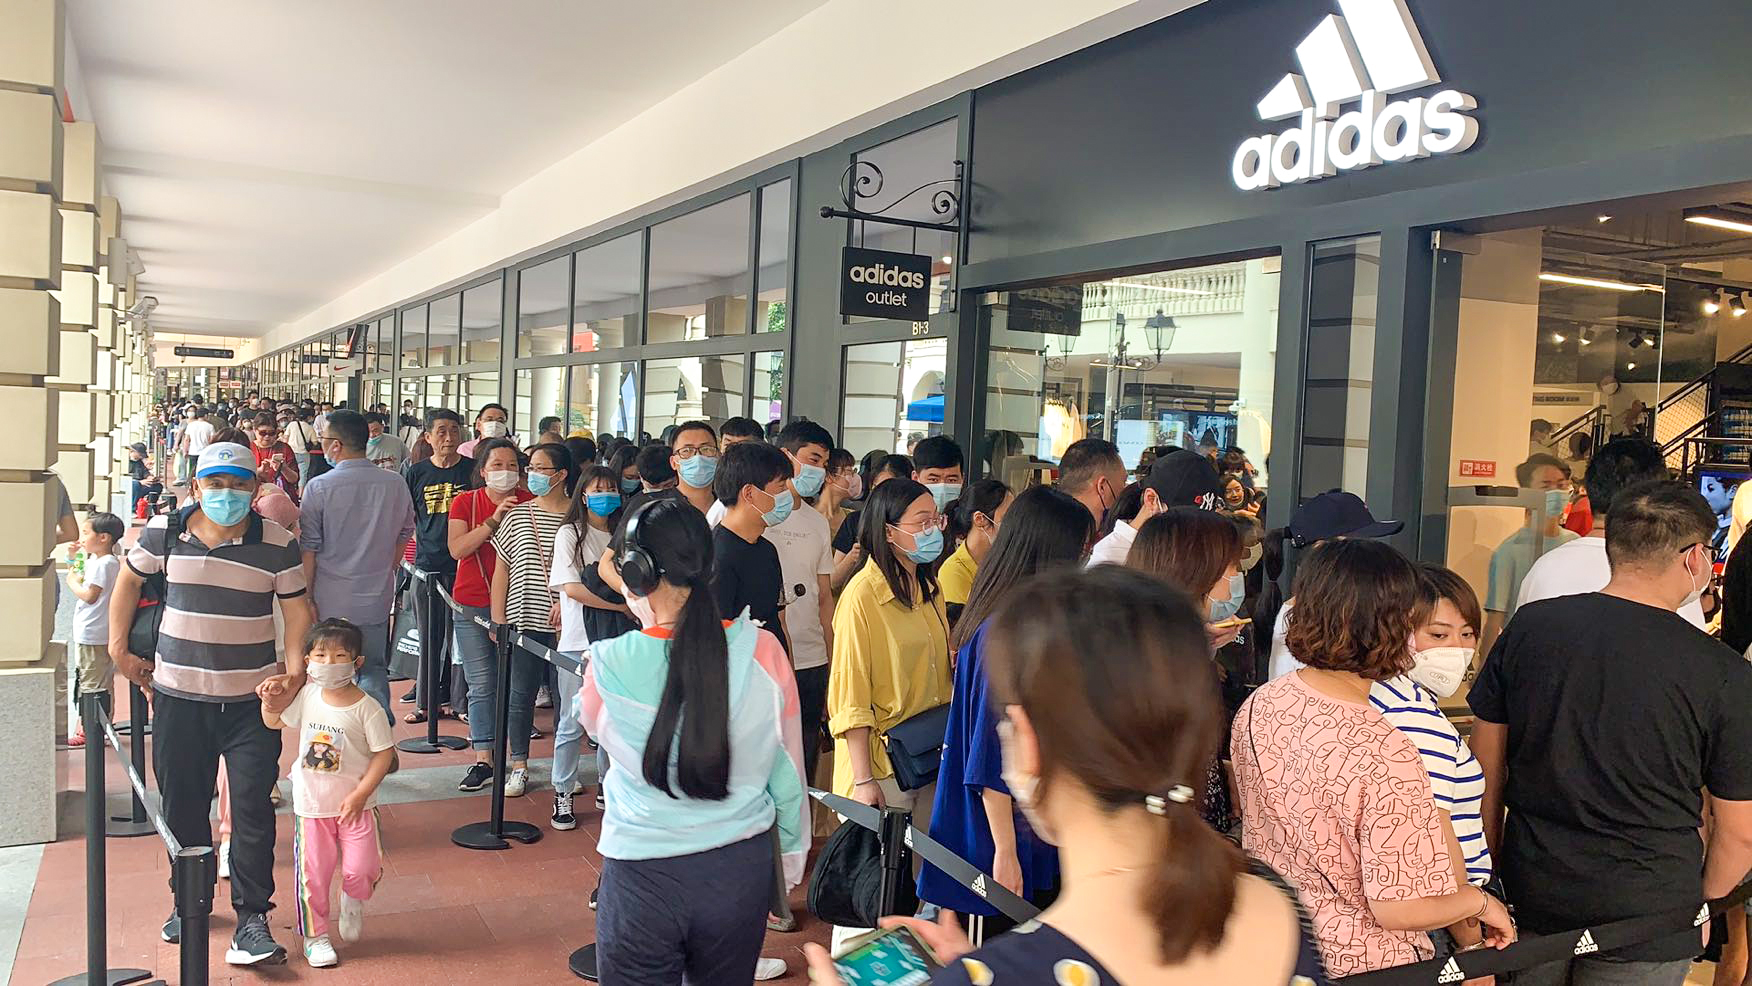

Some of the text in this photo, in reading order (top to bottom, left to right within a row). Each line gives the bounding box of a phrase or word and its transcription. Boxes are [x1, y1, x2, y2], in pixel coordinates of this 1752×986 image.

[1233, 89, 1478, 191] adidas
[849, 263, 925, 289] adidas
[865, 290, 908, 307] outlet
[1574, 942, 1599, 955] adidas
[1437, 970, 1465, 984] adidas
